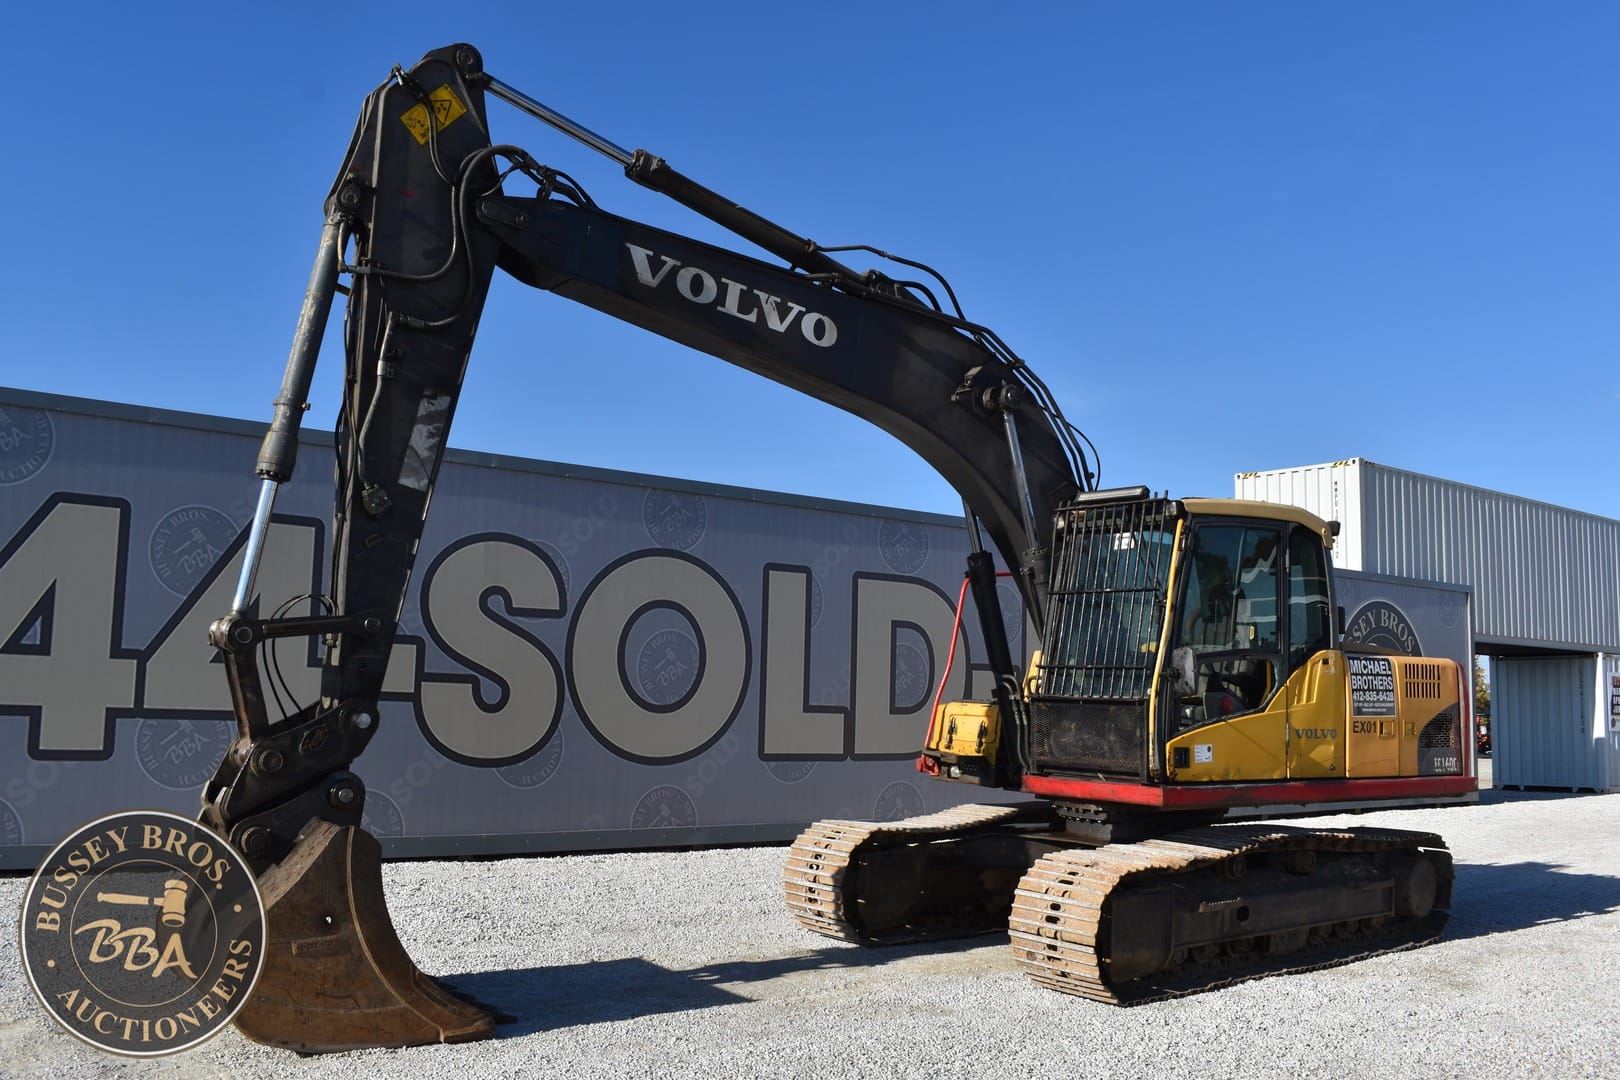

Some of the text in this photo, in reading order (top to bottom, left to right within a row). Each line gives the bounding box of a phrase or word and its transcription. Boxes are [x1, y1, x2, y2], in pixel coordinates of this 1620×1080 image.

[624, 243, 838, 347] VOLVO
[1350, 659, 1392, 675] MICHAEL
[1351, 675, 1393, 690] BROTHERS
[1295, 728, 1337, 740] VOLVO
[1352, 721, 1377, 734] EX01
